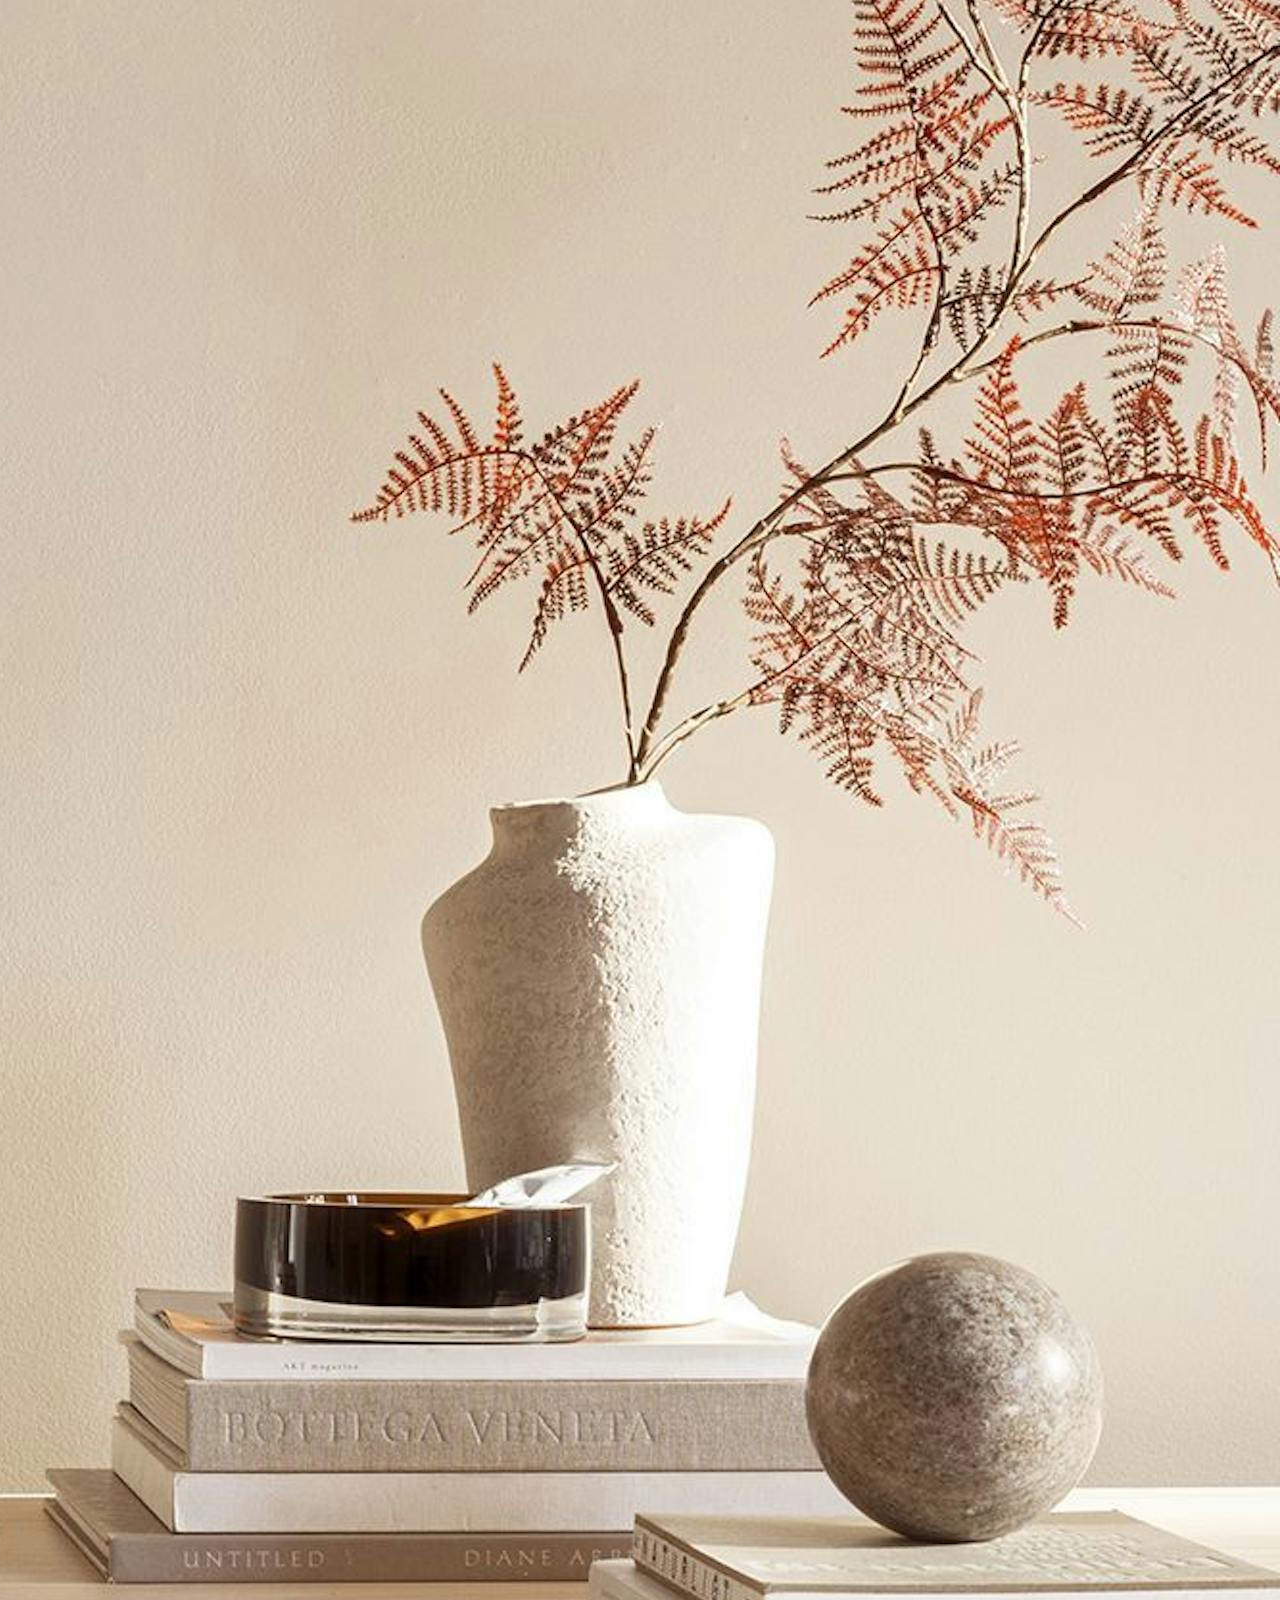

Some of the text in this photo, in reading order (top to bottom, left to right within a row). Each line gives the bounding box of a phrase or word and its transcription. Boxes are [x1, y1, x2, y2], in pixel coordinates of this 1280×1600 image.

[223, 1410, 657, 1444] BOTTEGA VENETA
[183, 1549, 325, 1568] UNTITLED
[464, 1549, 553, 1567] DIANE
